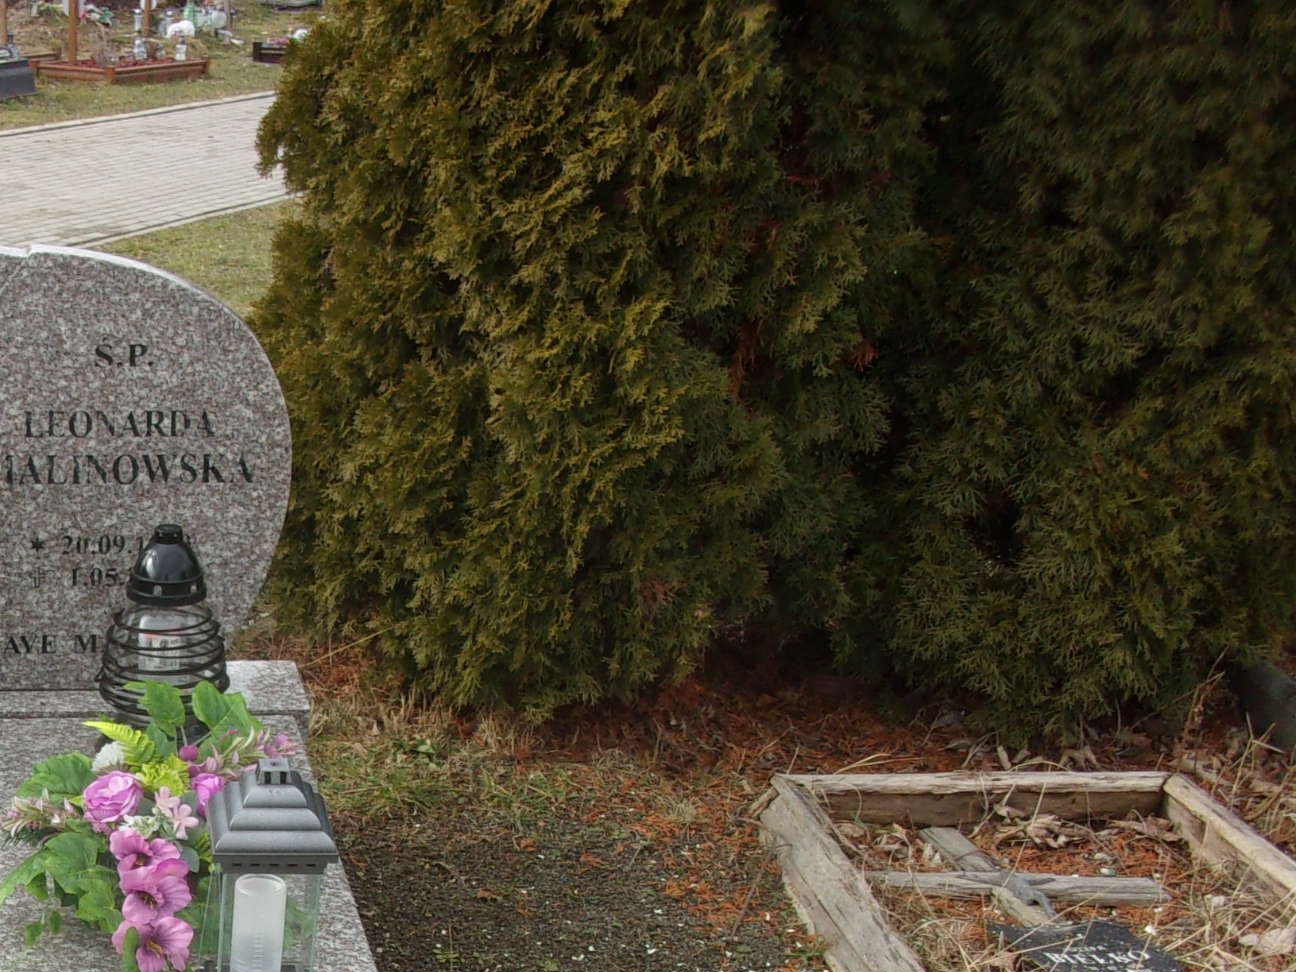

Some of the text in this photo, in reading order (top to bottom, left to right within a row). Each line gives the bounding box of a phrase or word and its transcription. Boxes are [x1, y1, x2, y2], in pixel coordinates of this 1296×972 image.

[24, 410, 215, 438] LEONARDA
[62, 534, 193, 555] 20.09.1
[3, 634, 57, 654] AVE
